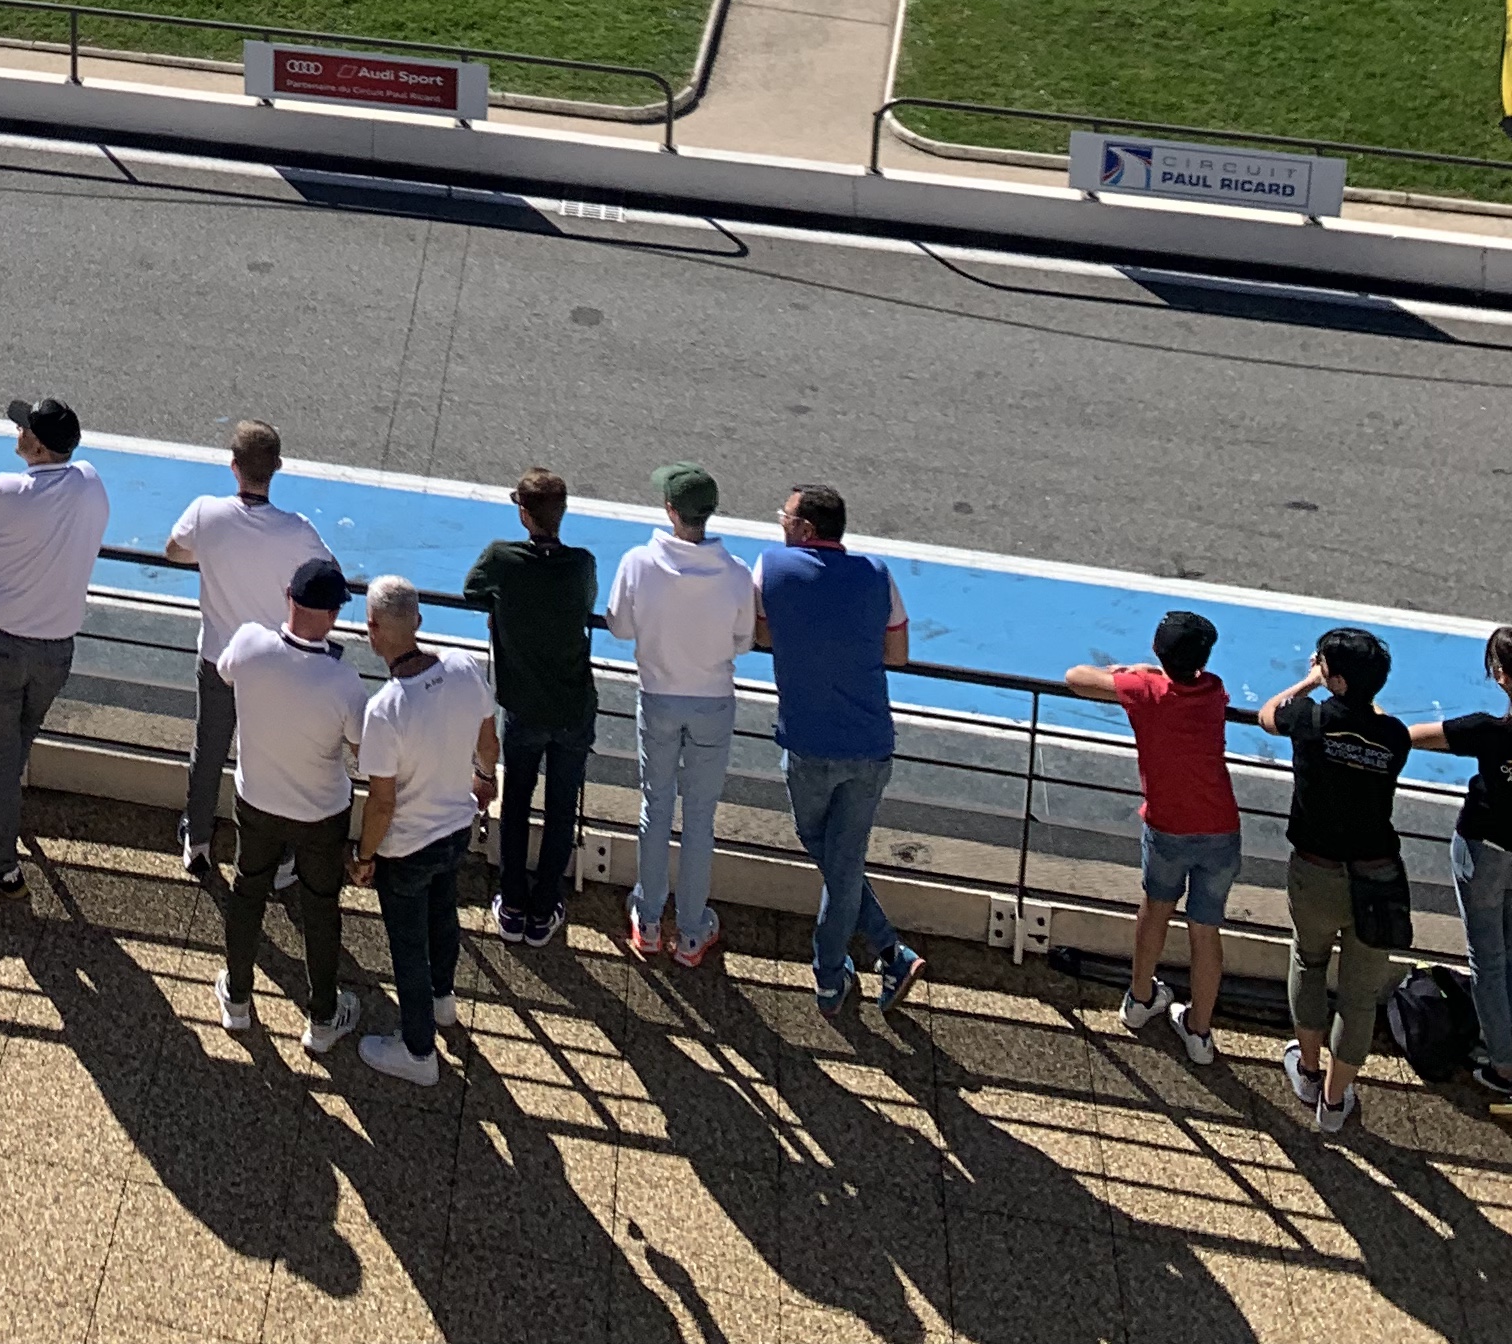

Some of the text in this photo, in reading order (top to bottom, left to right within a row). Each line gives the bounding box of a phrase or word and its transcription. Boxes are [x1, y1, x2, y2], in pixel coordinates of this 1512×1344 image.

[358, 66, 444, 86] Audi Sport
[1162, 155, 1298, 179] CIRCUIT
[1161, 171, 1296, 198] PAUL RICARD
